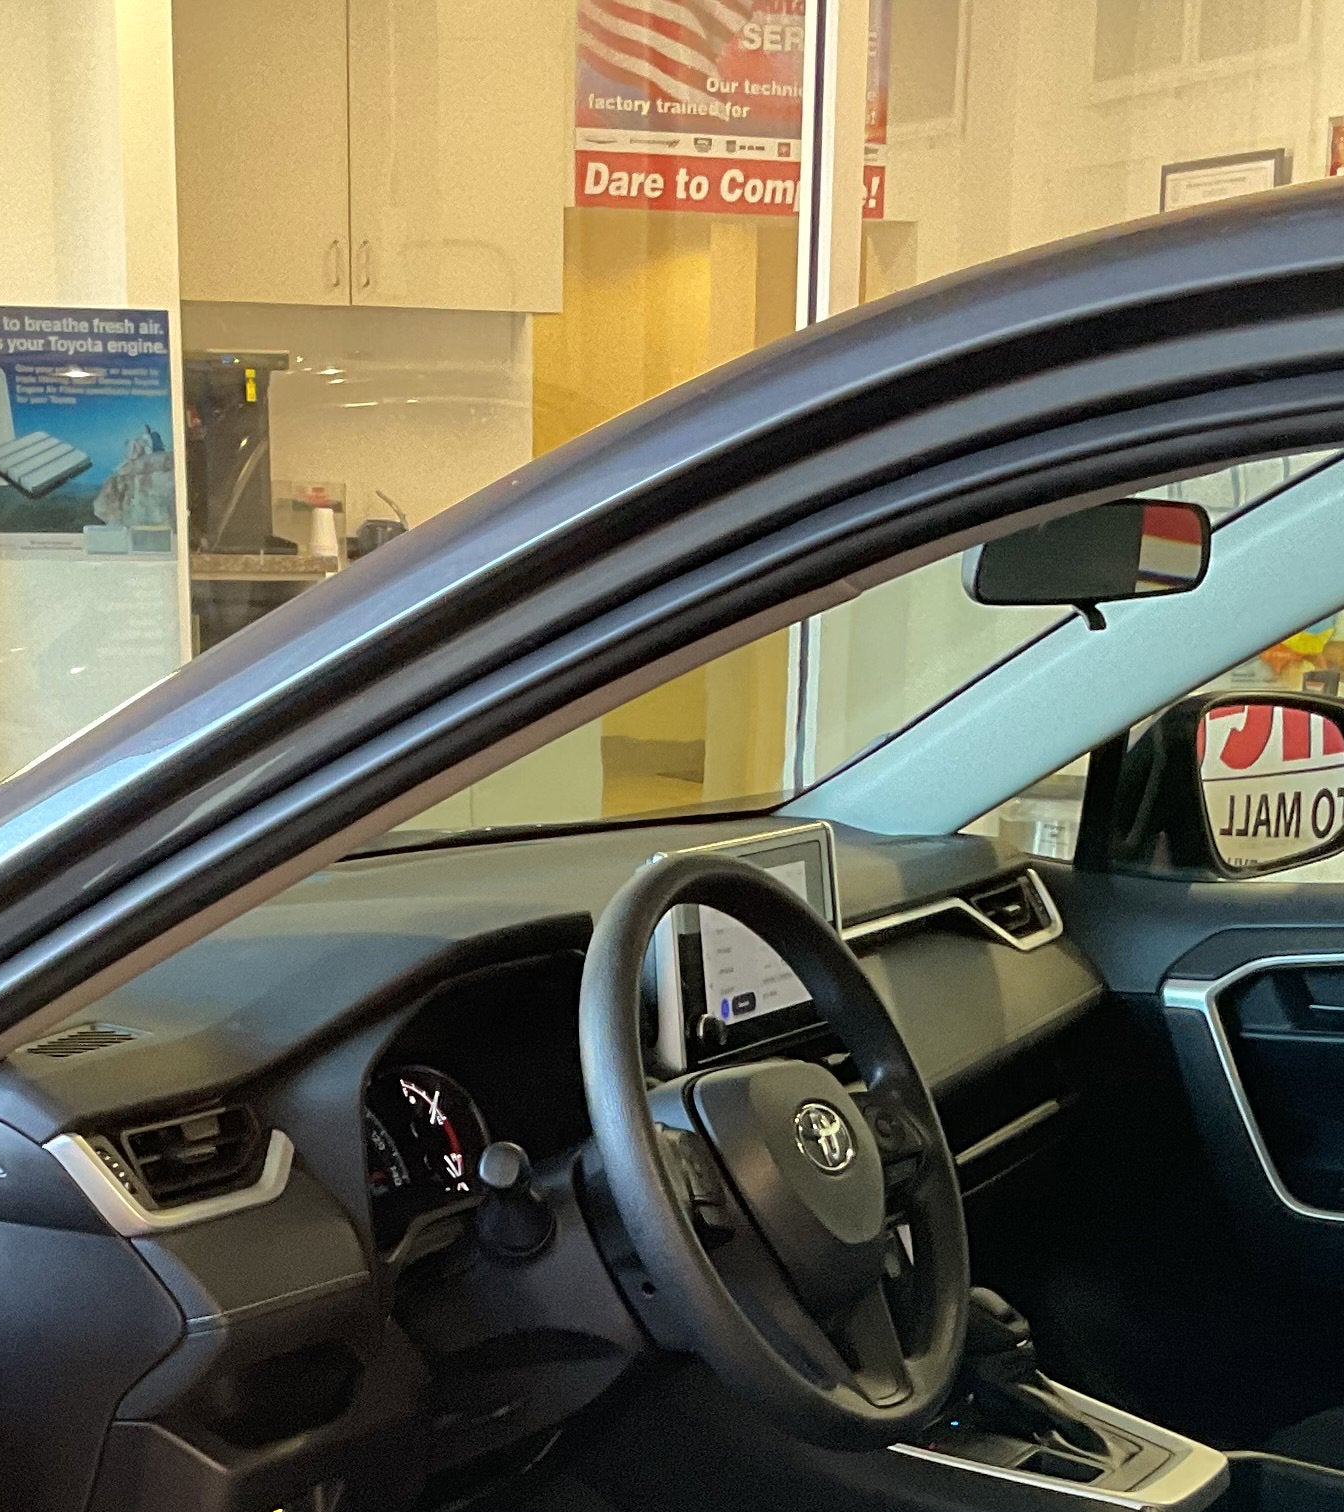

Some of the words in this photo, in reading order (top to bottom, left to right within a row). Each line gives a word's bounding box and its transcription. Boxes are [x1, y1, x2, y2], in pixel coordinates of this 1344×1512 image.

[706, 77, 738, 94] Our
[588, 94, 651, 115] factory
[656, 98, 722, 116] trained
[725, 100, 750, 118] for
[584, 162, 665, 199] Dare
[675, 168, 709, 200] to
[3, 316, 21, 331] to
[25, 316, 88, 333] breathe
[93, 318, 134, 334] fresh
[138, 319, 164, 335] air.
[7, 338, 44, 353] your
[48, 336, 103, 355] Toyota
[107, 339, 167, 356] engine.
